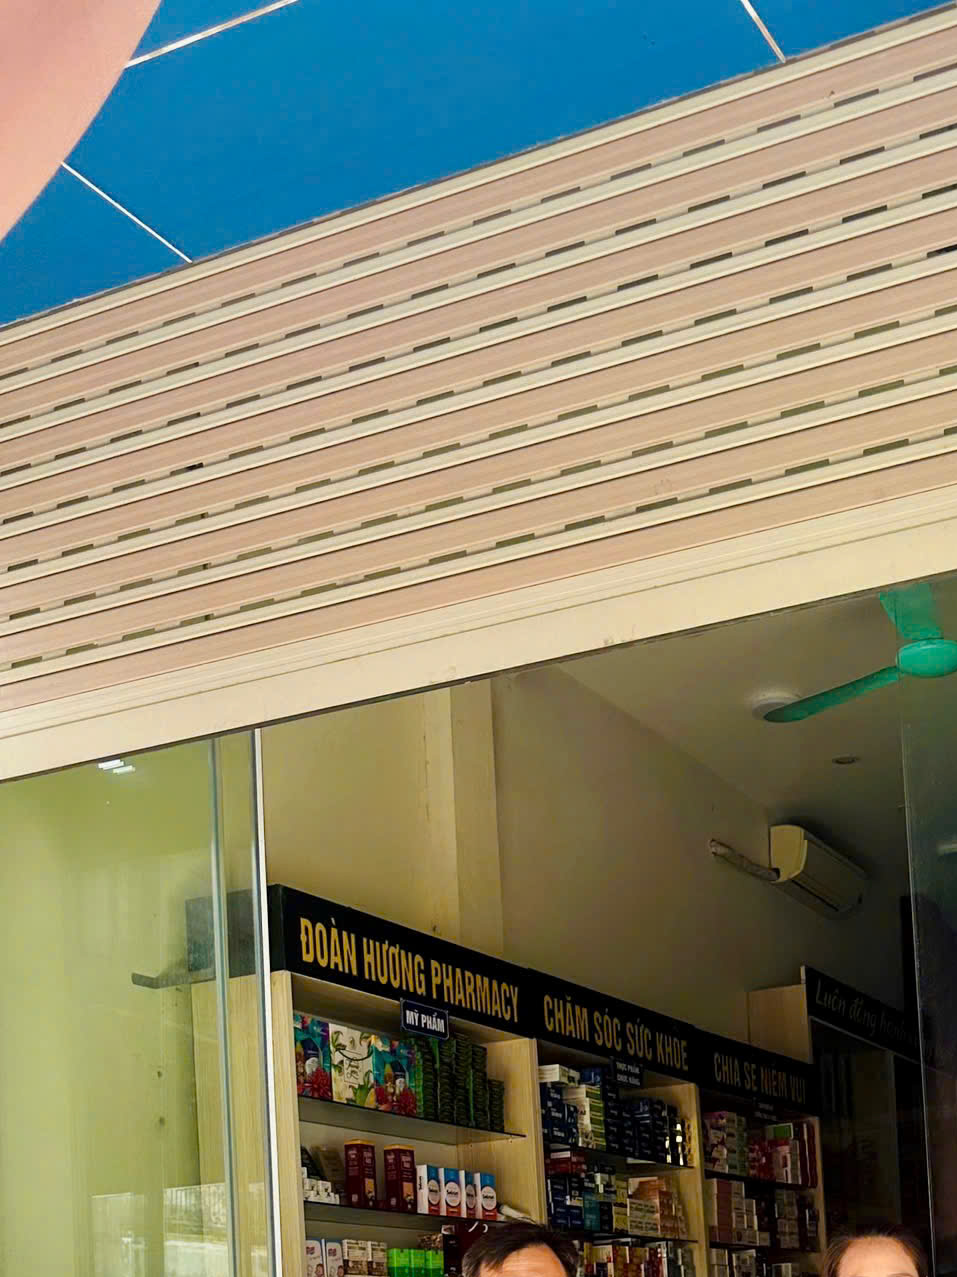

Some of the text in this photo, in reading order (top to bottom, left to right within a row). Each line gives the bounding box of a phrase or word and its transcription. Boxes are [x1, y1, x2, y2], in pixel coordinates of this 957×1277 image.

[300, 917, 519, 1023] ĐOÀN HƯƠNG PHARMACY
[543, 994, 653, 1062] CHĂM SÓC SỨC
[713, 1052, 742, 1088] CHIA
